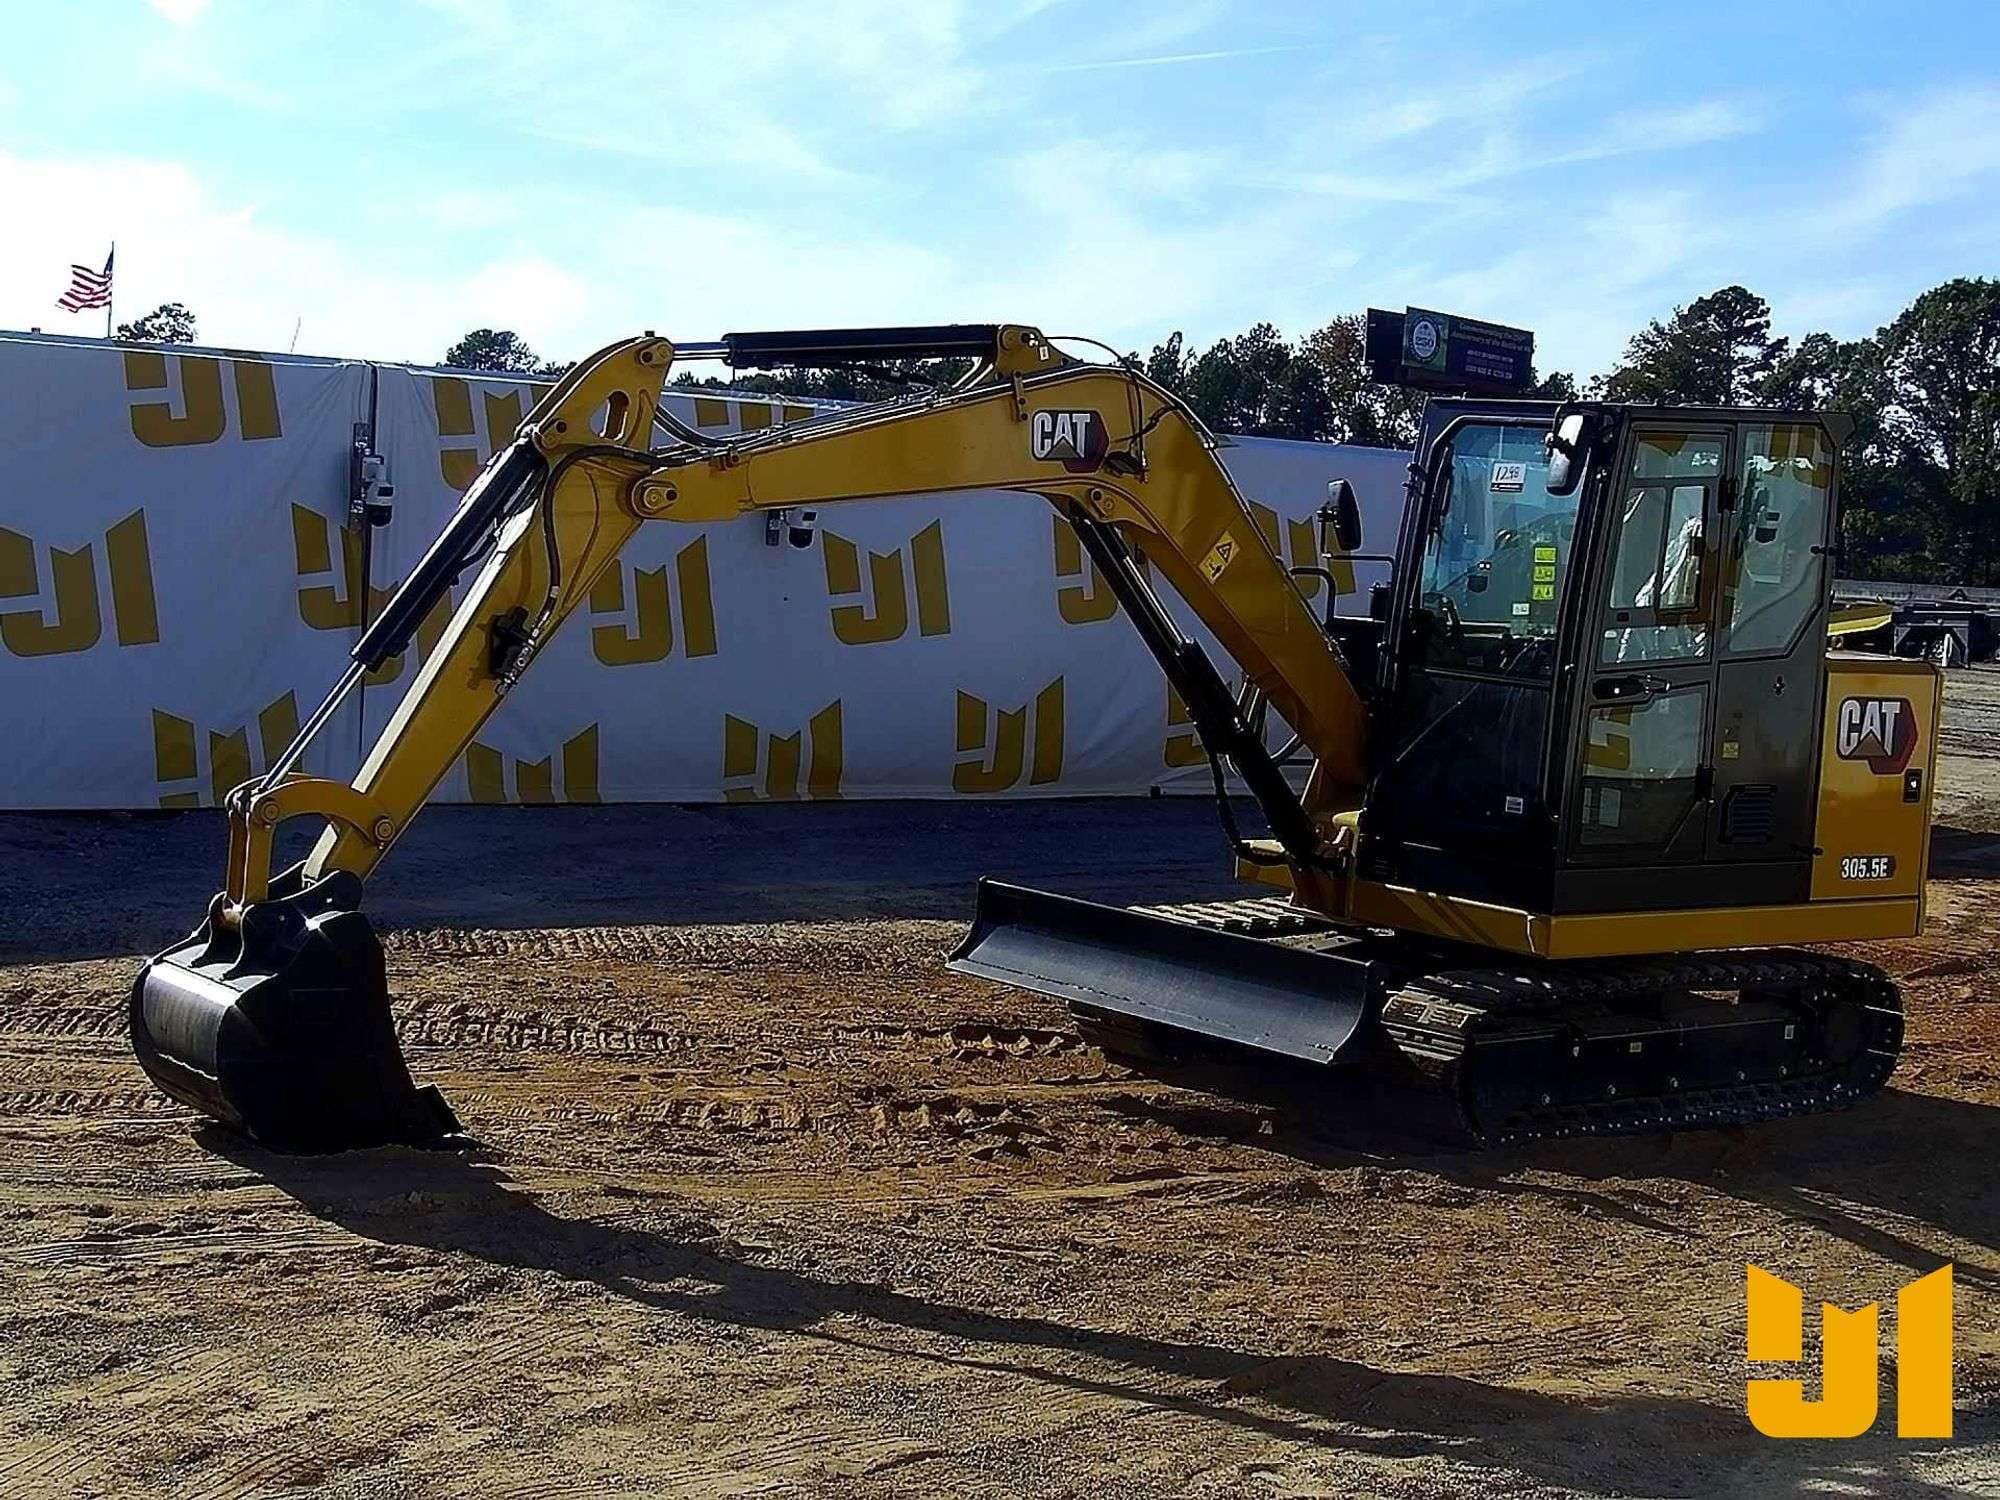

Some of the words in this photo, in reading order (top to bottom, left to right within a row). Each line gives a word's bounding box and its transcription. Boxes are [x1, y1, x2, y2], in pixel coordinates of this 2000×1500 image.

[1033, 412, 1090, 459] CAT
[1839, 699, 1900, 756] CAT
[1841, 857, 1888, 878] 305.5E
